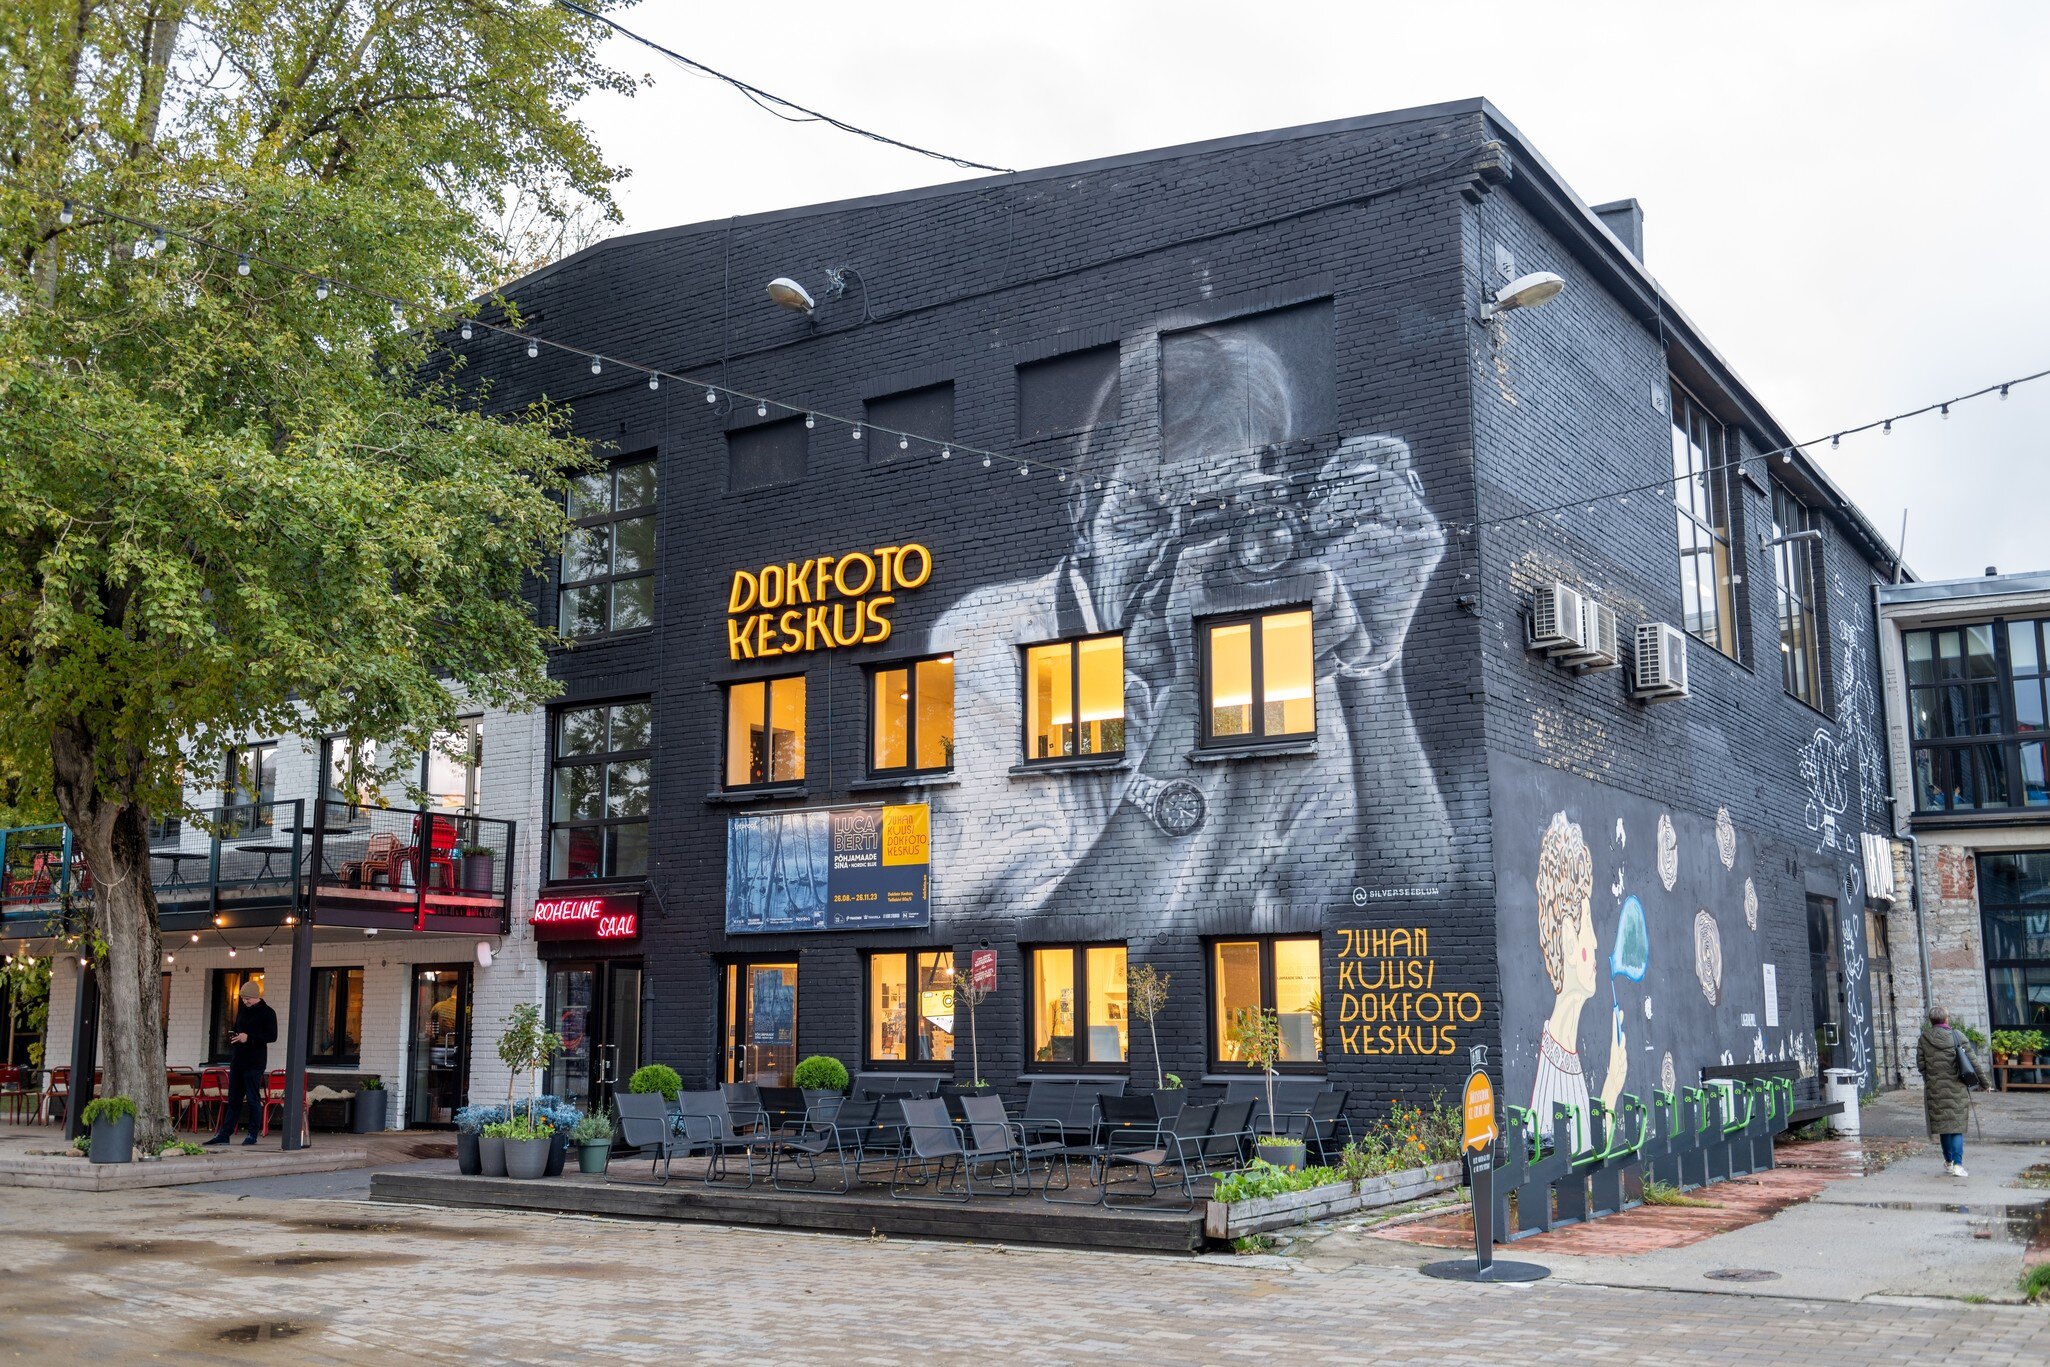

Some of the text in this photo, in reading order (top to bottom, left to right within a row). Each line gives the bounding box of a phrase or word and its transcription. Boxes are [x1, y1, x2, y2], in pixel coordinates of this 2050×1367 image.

[728, 544, 932, 614] DOKFOTO
[728, 596, 895, 660] KESKUS
[834, 815, 876, 835] LUCA
[887, 815, 914, 826] JUHAN
[887, 825, 915, 836] KUUSI
[834, 832, 878, 852] BERTI
[887, 834, 927, 847] DOKFOTO
[887, 845, 920, 856] KESKUS
[834, 853, 877, 862] PÕHJAMAADE
[534, 900, 602, 922] ROHELINE
[597, 915, 634, 937] SAAL
[1337, 928, 1428, 958] JUHAN
[1338, 959, 1434, 990] KUUSI
[1339, 992, 1482, 1022] DOKFOTO
[1339, 1025, 1457, 1055] KESKUS
[1510, 1117, 1519, 1126] 10
